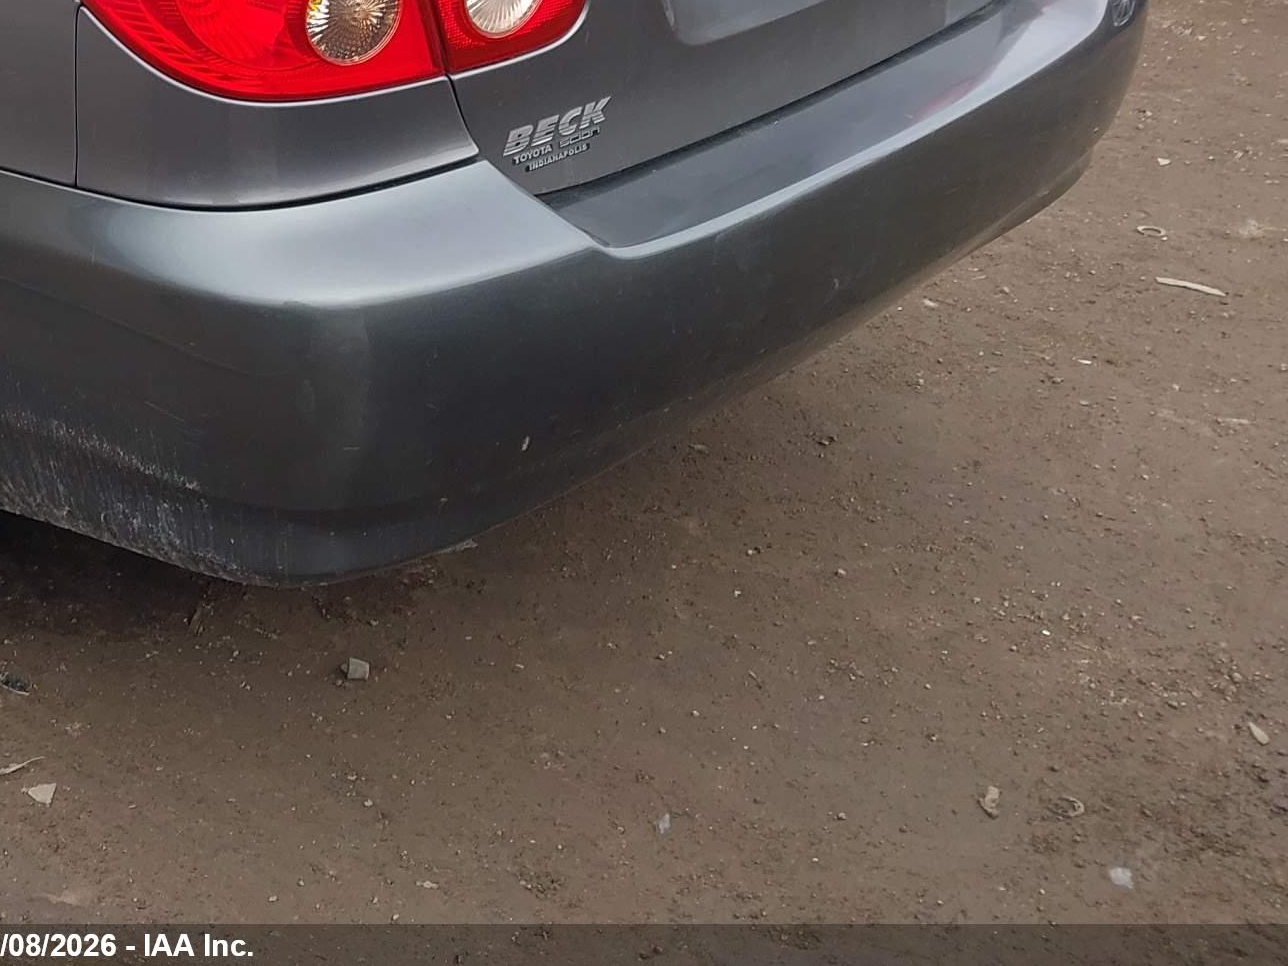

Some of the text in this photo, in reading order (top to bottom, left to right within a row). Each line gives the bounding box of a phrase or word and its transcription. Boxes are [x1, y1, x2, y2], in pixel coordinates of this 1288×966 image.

[502, 95, 612, 157] BECK
[512, 143, 553, 165] TOYOTA
[527, 142, 589, 172] INDIANAPOLIS
